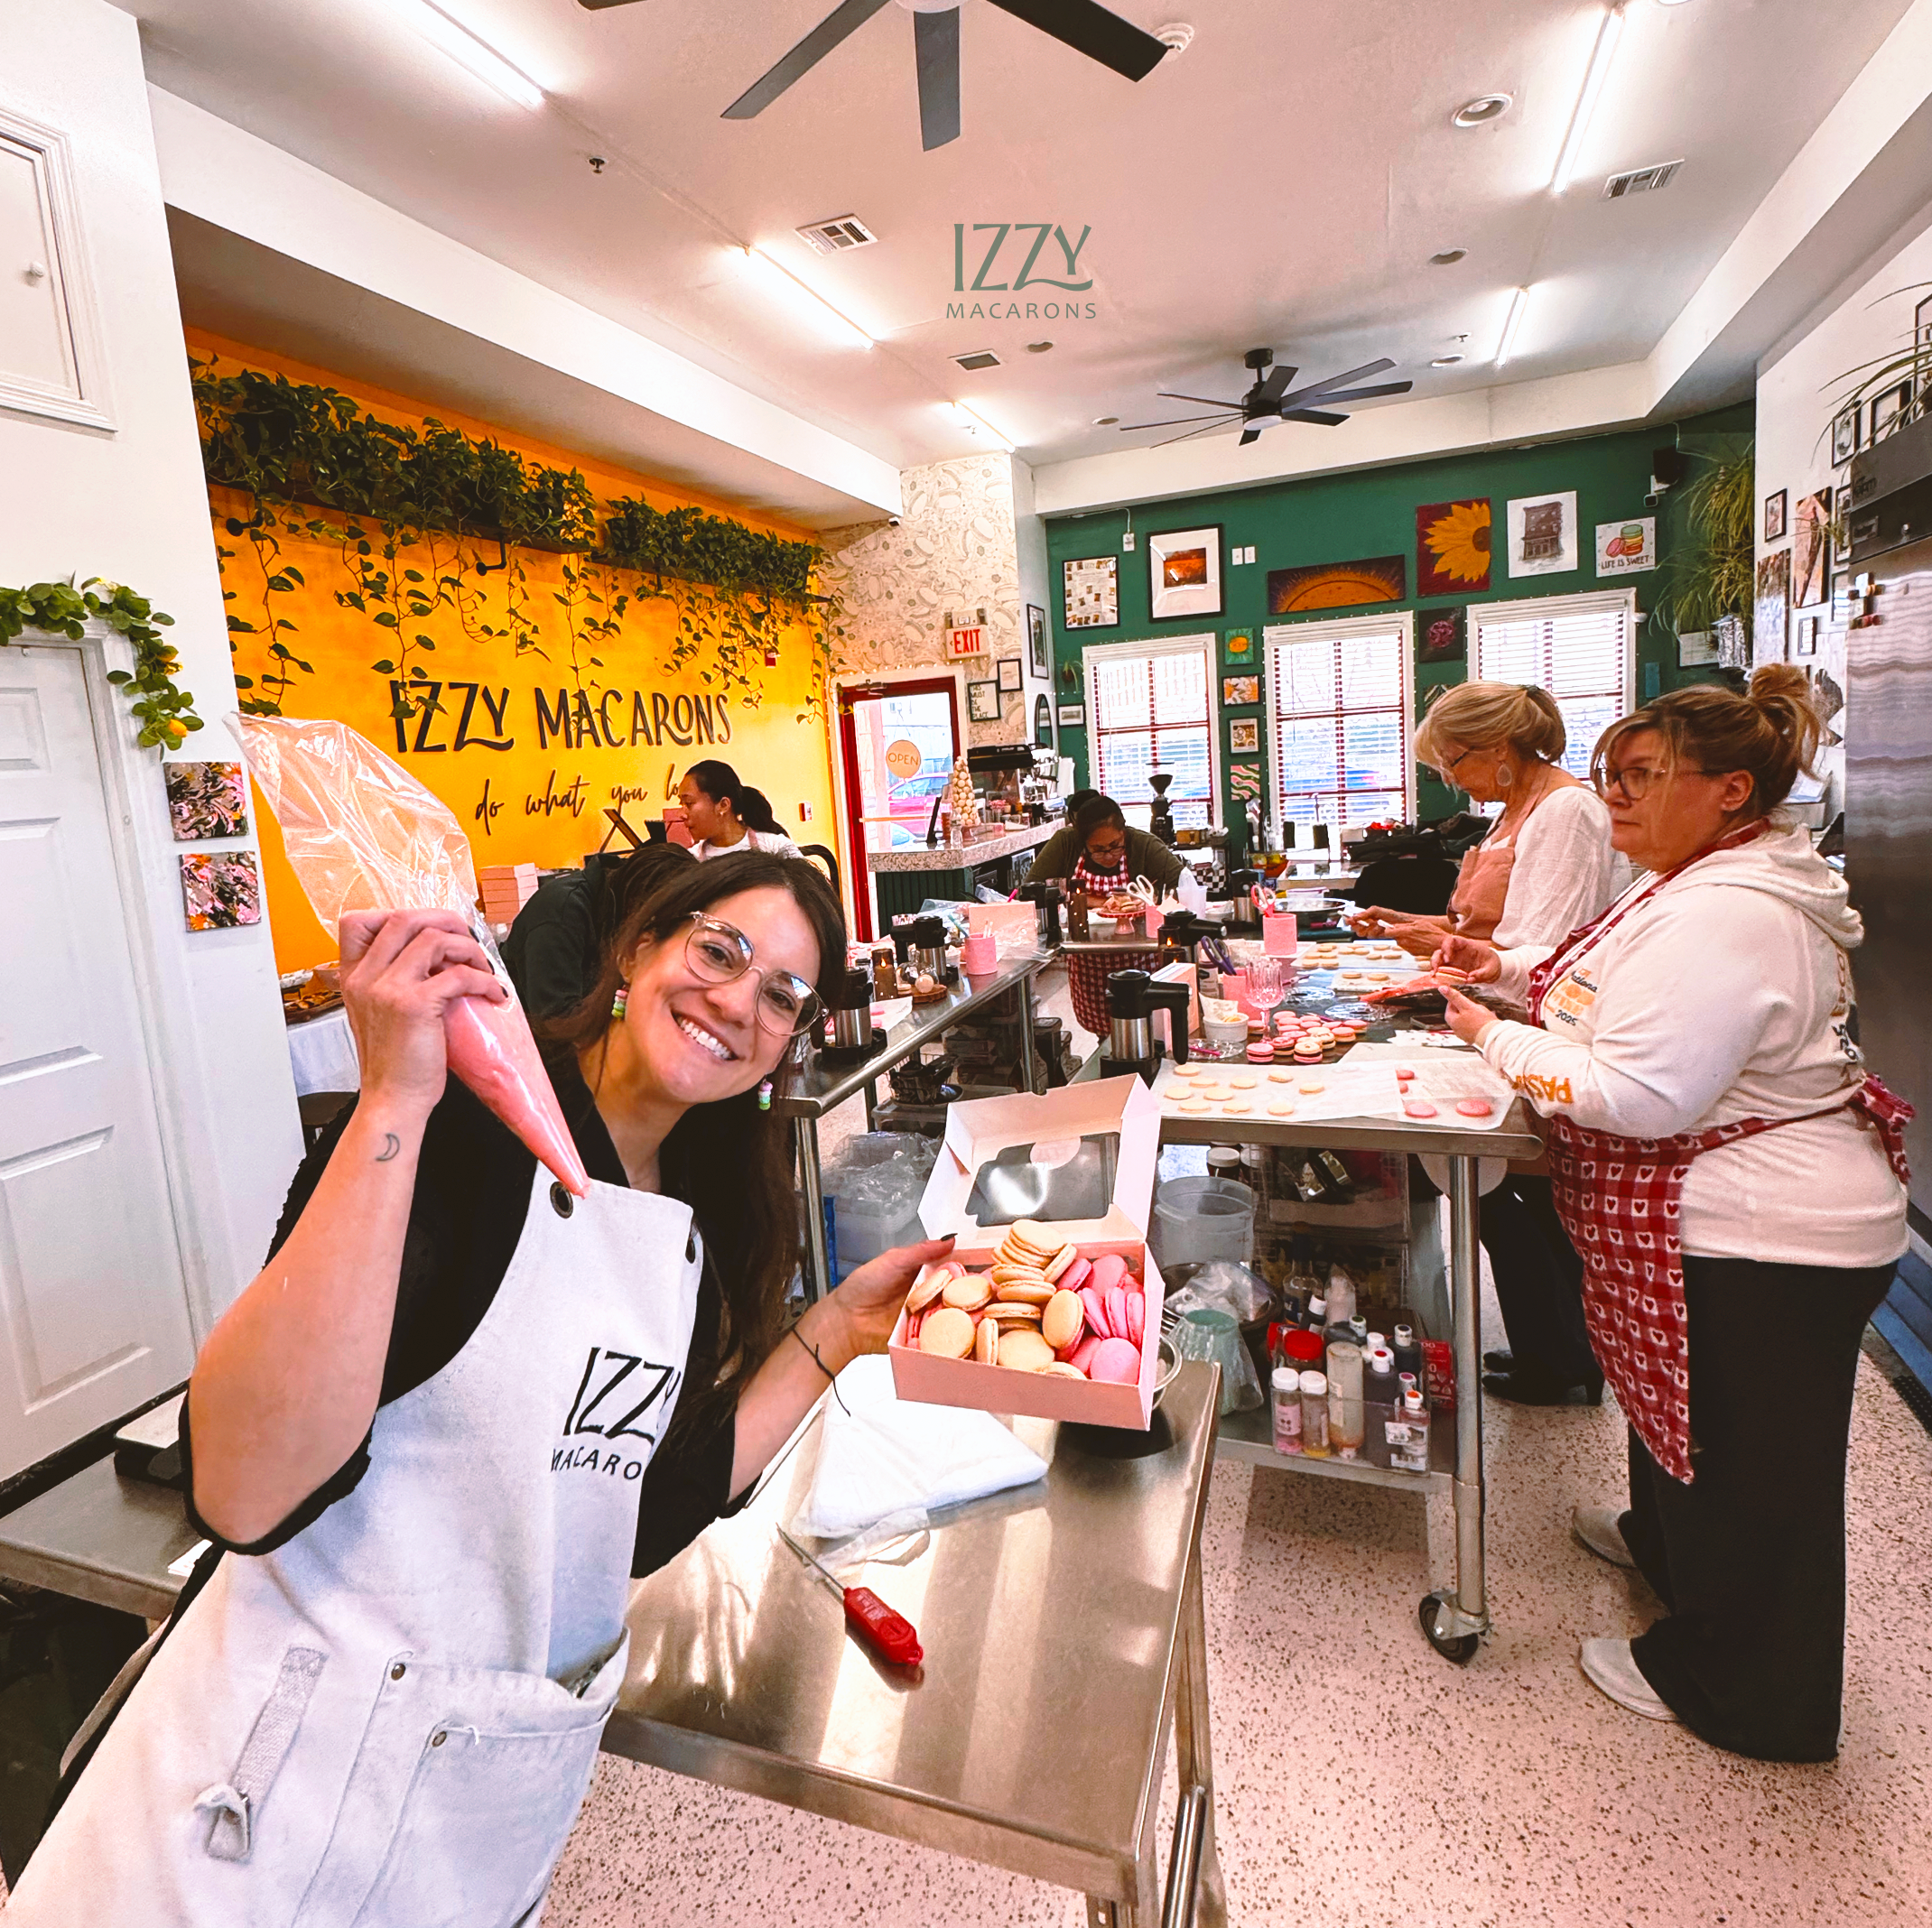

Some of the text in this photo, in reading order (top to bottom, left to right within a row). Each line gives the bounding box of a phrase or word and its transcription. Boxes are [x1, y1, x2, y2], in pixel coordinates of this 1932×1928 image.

[1601, 554, 1649, 570] LIFE IS SWEET
[953, 628, 981, 654] EXIT
[389, 680, 731, 753] IZZY MACARONS
[887, 752, 919, 766] OPEN
[475, 763, 679, 836] do what you lo
[1555, 1009, 1578, 1026] 2025
[551, 1446, 643, 1480] MACARO
